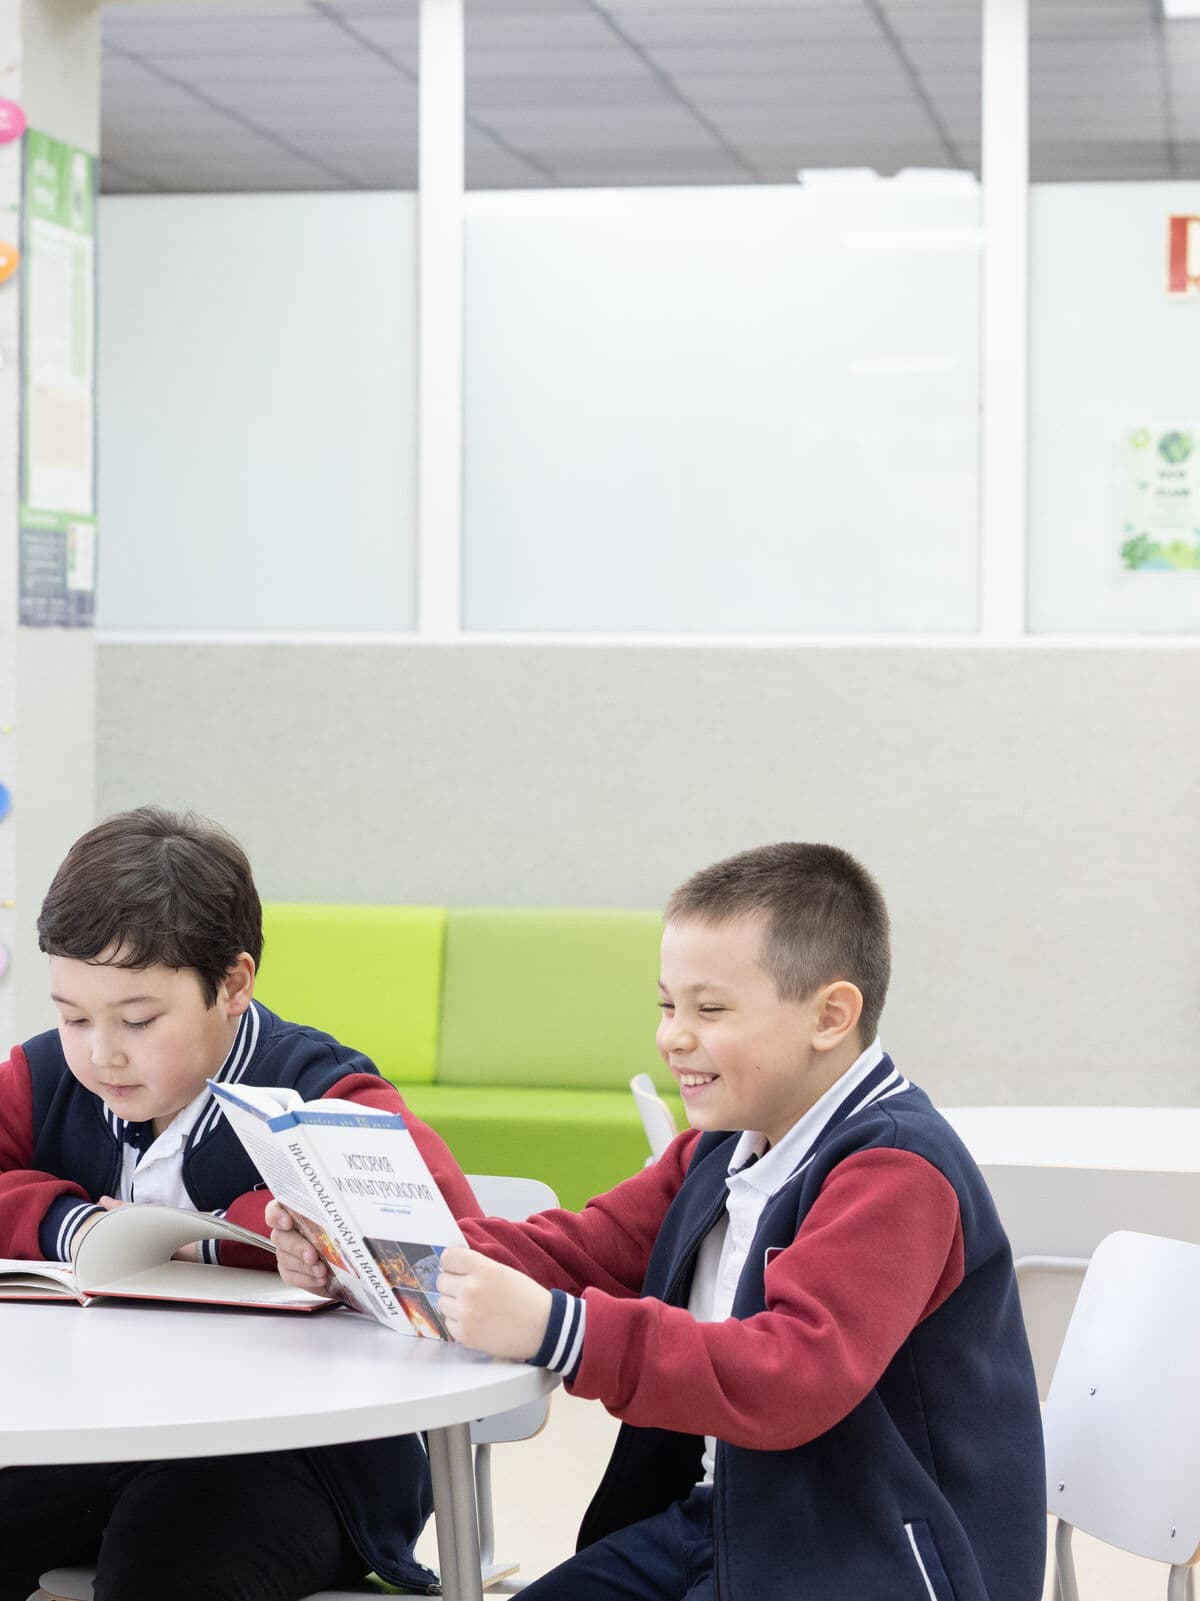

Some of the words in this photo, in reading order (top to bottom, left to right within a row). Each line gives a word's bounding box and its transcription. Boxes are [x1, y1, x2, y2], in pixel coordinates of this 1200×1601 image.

[344, 1153, 396, 1173] ИСТОРИЯ
[288, 1142, 357, 1245] КУЛЬТУРОЛОГИЯ
[344, 1177, 434, 1201] КУЛЬТУРОЛОГИЯ
[352, 1248, 365, 1259] И
[360, 1261, 399, 1316] ИСТОРИЯ
